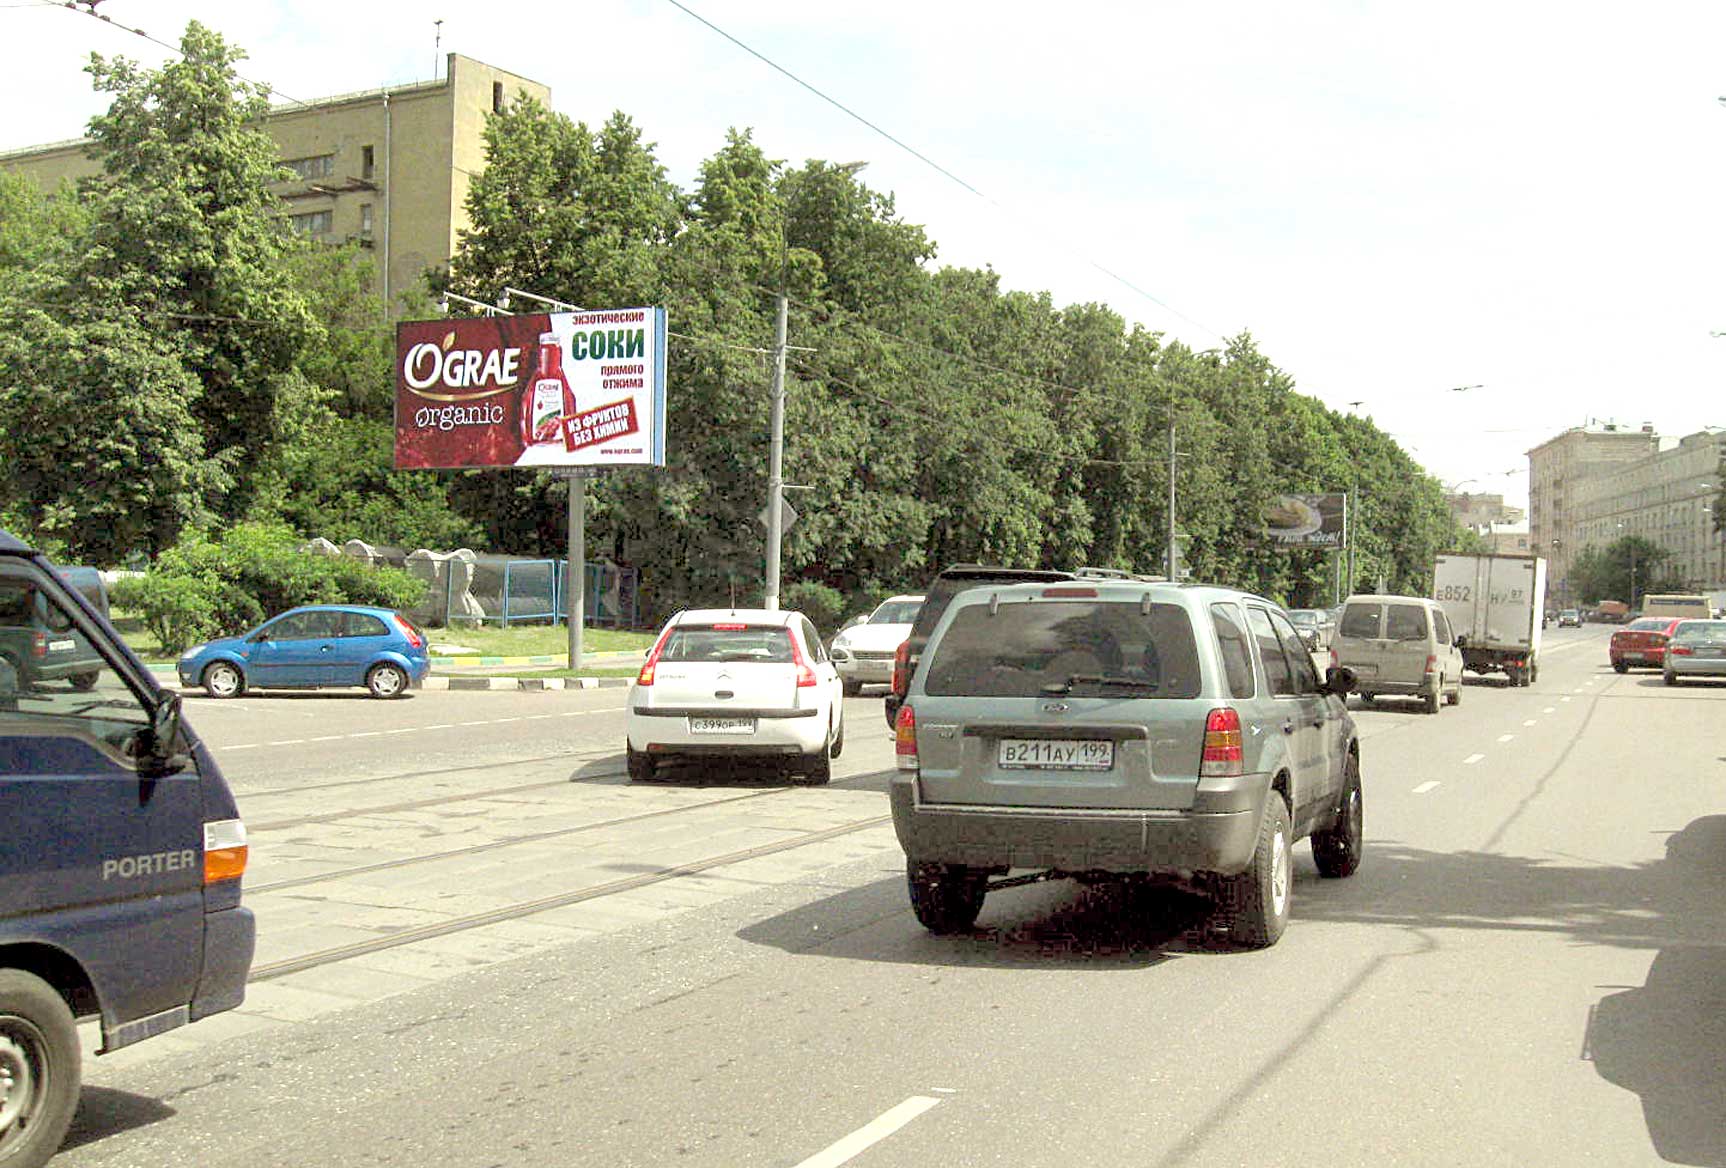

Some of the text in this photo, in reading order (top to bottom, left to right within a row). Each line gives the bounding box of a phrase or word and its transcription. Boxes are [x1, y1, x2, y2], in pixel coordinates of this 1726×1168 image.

[572, 328, 645, 361] СОКИ
[415, 403, 504, 431] organic
[567, 403, 630, 434] ИЗ ФРУКТОВ
[573, 417, 629, 446] БЕЗ ХИМИИ
[102, 849, 196, 880] PORTER
